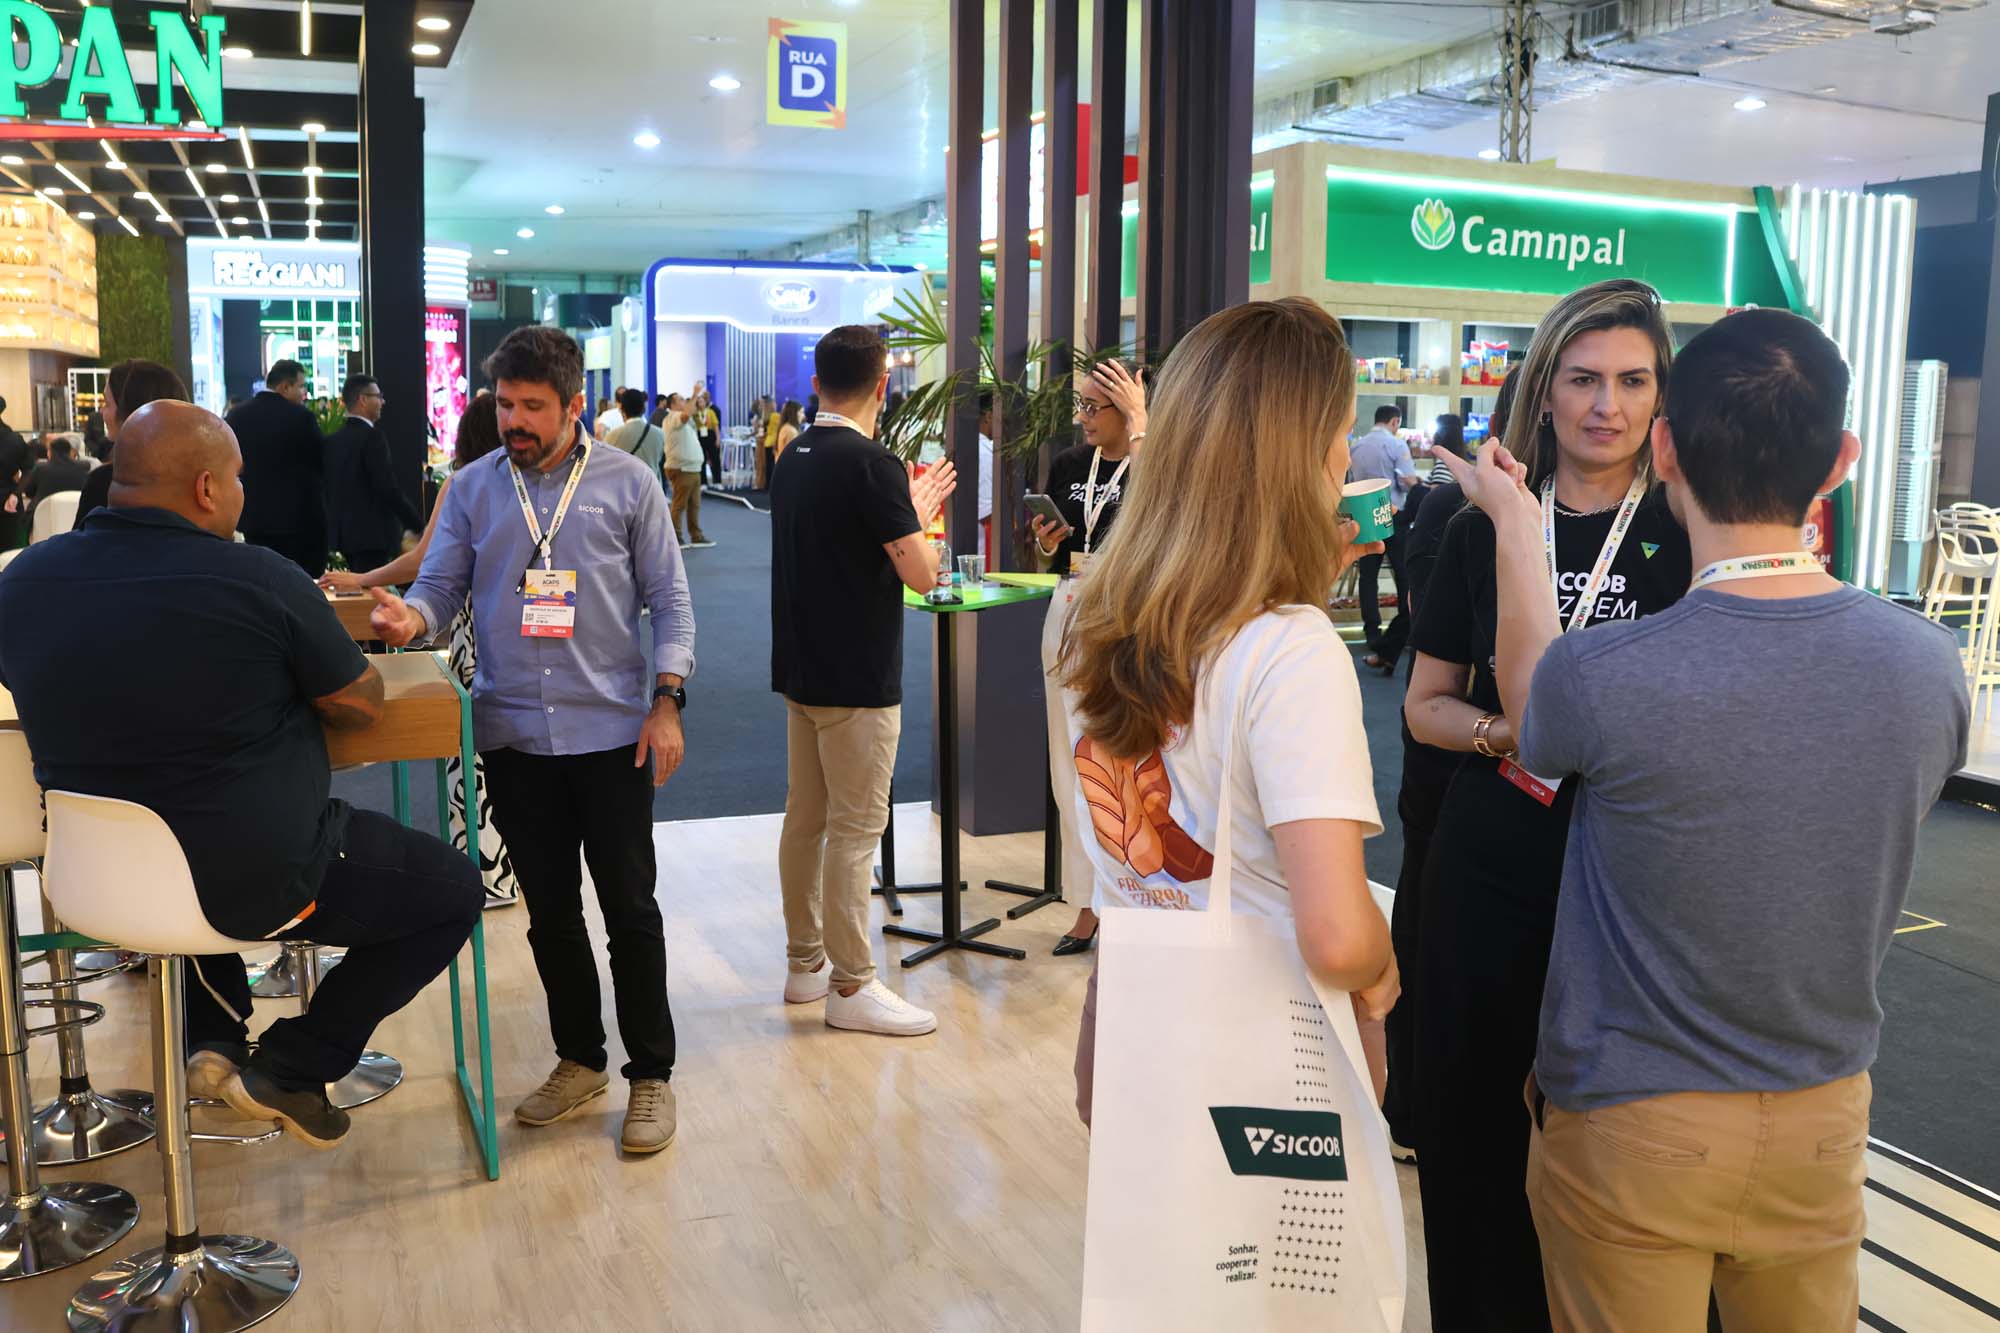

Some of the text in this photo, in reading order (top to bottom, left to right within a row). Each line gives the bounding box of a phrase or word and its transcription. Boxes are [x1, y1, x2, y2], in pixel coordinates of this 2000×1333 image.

[0, 0, 226, 127] PAN
[788, 50, 827, 66] RUA
[791, 64, 825, 98] D
[1461, 215, 1626, 271] Camnpal
[213, 261, 345, 288] REGGIANI
[1272, 1134, 1340, 1157] SICOOB
[1228, 1243, 1259, 1256] Sonhar,
[1215, 1258, 1258, 1272] cooperar e
[1225, 1271, 1257, 1283] realizar.
